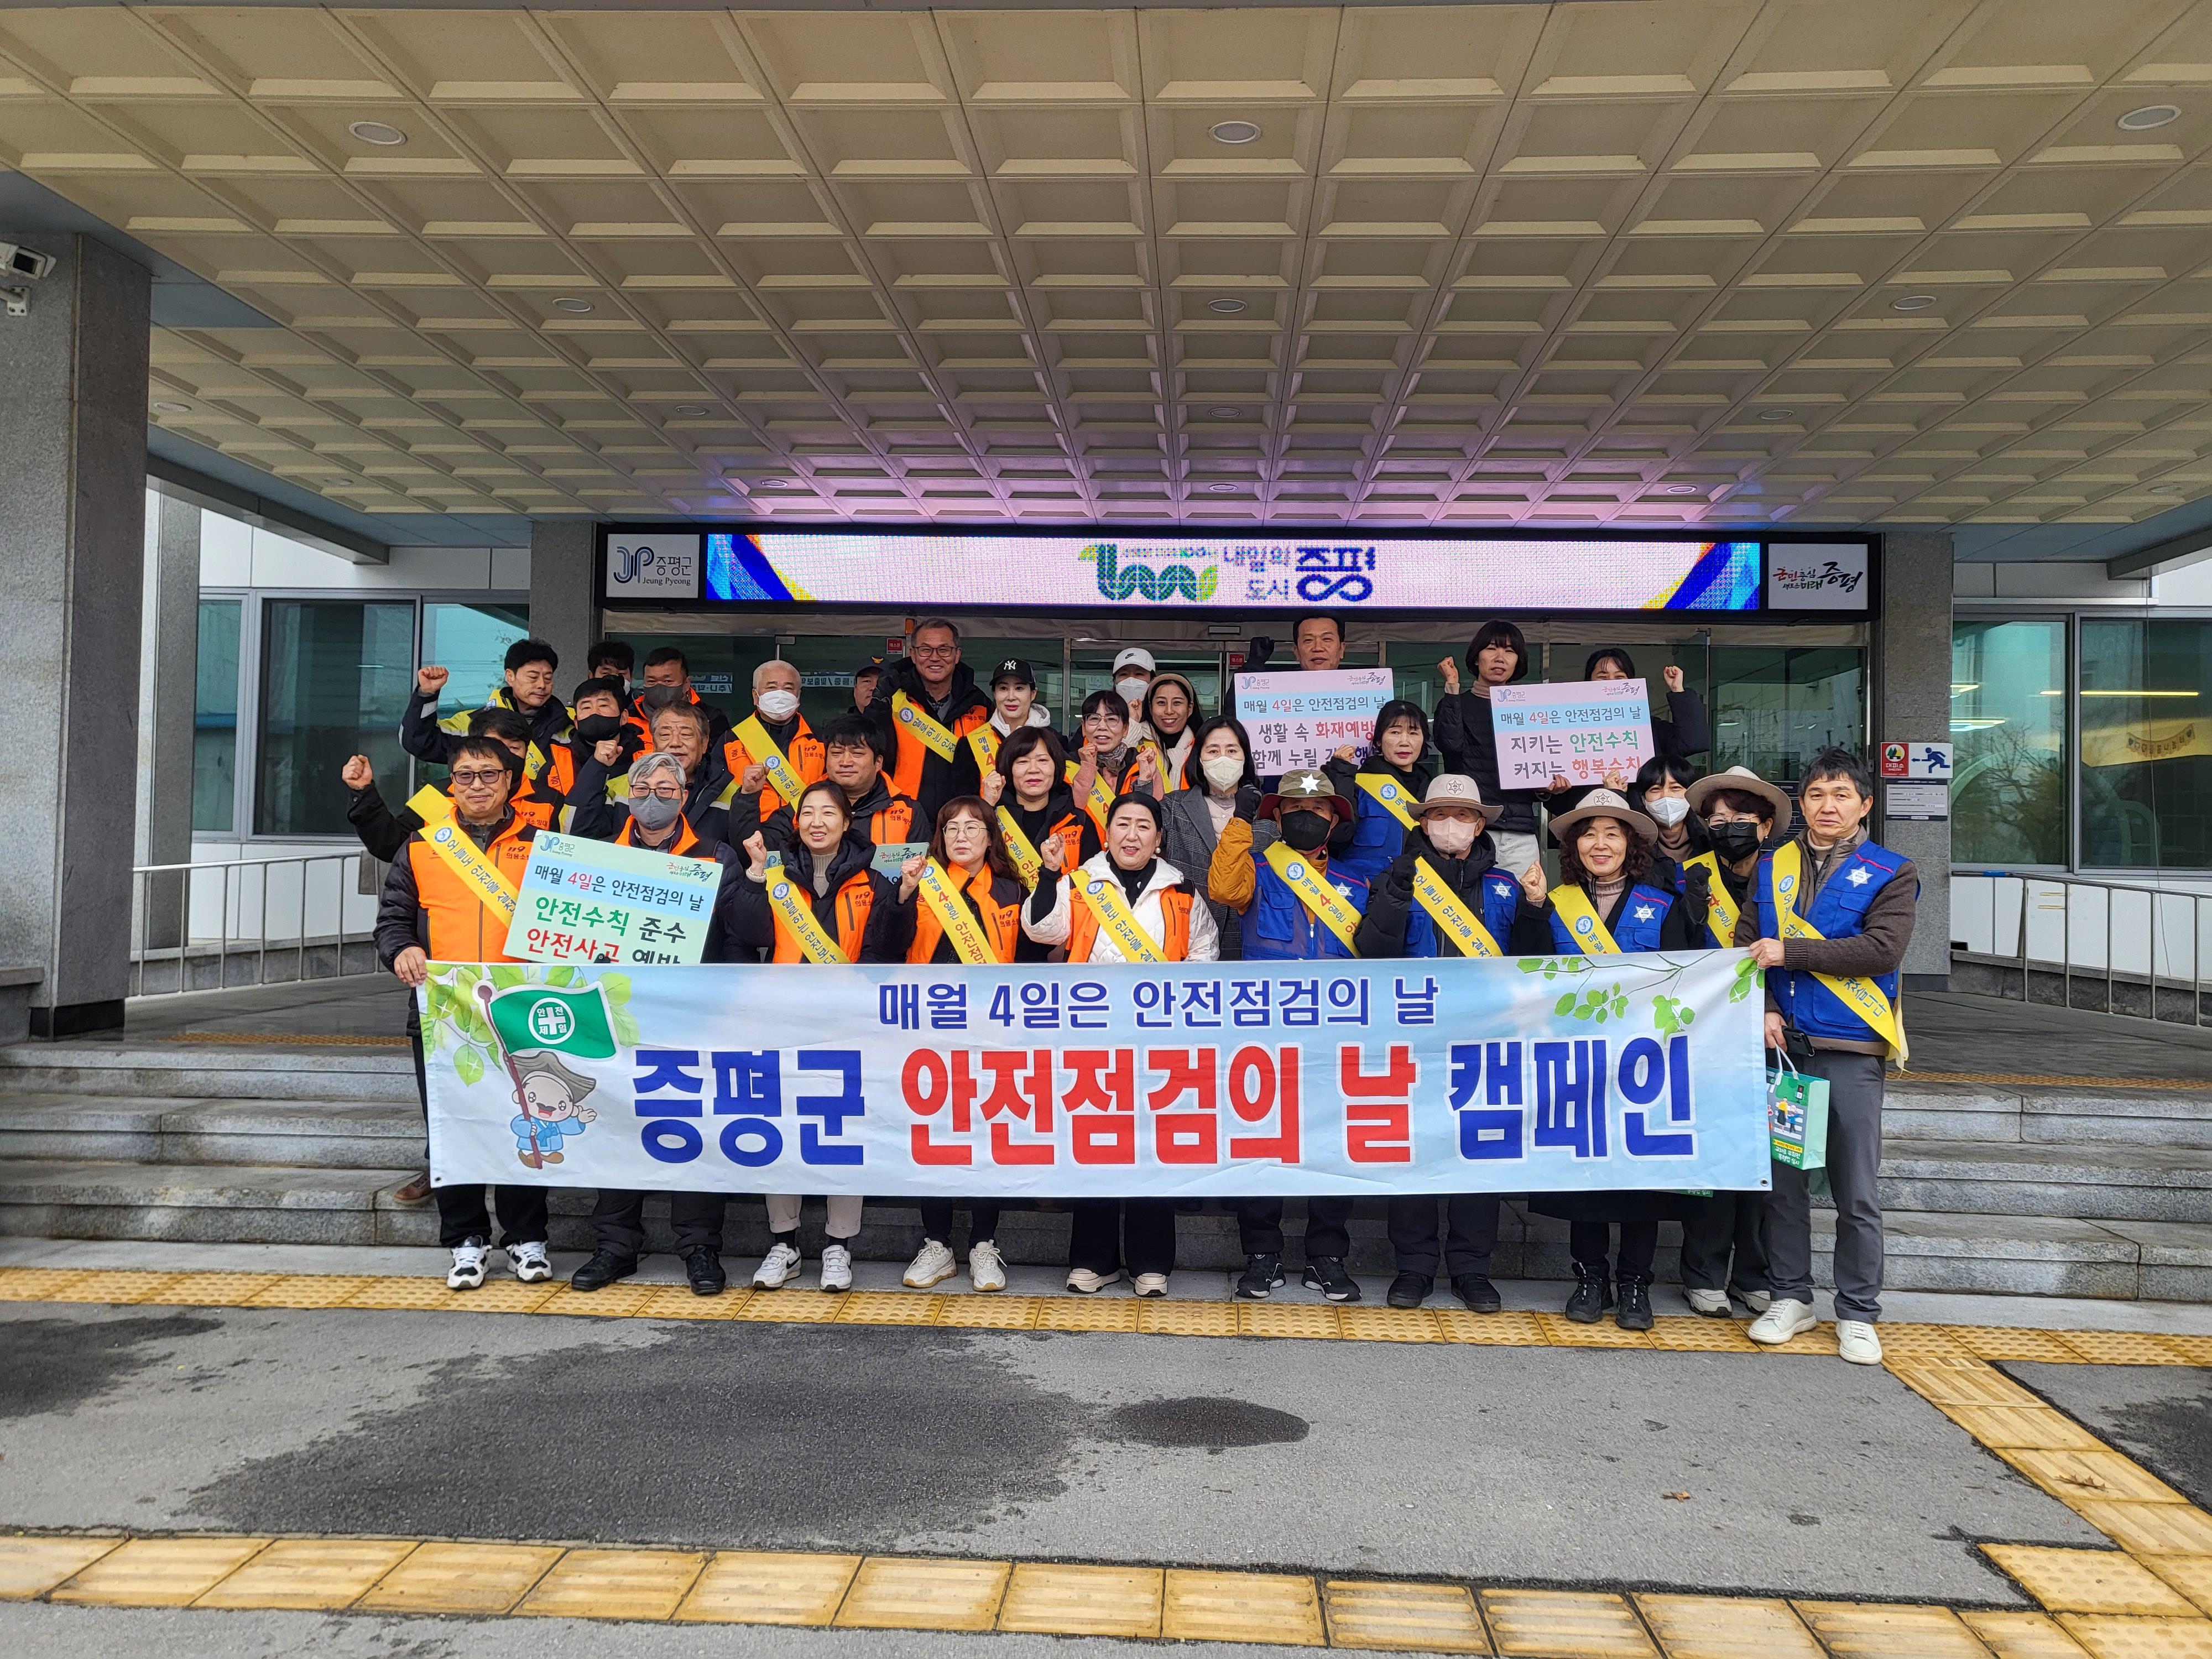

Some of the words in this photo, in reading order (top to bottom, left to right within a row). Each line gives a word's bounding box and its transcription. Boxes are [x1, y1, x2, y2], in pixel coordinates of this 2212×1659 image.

[656, 556, 692, 576] 증평군
[1223, 546, 1290, 572] 내일의
[642, 577, 663, 586] Jeung
[665, 577, 691, 586] Pyeong
[1817, 561, 1864, 593] 증평
[1245, 578, 1290, 601] 도시
[1004, 660, 1016, 670] NY
[1621, 682, 1641, 696] 증평
[1244, 699, 1267, 713] 매월
[1272, 698, 1305, 713] 4일은
[1308, 696, 1369, 712] 안전점검의
[1374, 696, 1386, 709] 날
[1500, 712, 1525, 726] 매월
[1529, 710, 1562, 724] 4일은
[1565, 707, 1625, 723] 안전점검의
[1629, 706, 1641, 719] 날
[1259, 722, 1288, 744] 생활
[1294, 722, 1310, 742] 속
[1315, 721, 1375, 741] 화재예방
[1511, 735, 1563, 754] 지키는
[1569, 731, 1639, 753] 안전수칙
[978, 736, 990, 753] 매월
[1251, 749, 1282, 770] 함께
[1288, 748, 1317, 768] 누릴
[1514, 761, 1566, 780] 커지는
[447, 839, 474, 867] 오늘도
[471, 864, 500, 894] 안전을
[691, 863, 713, 882] 증평
[535, 865, 564, 885] 매월
[567, 872, 606, 893] 4일은
[612, 880, 684, 906] 안전점검의
[689, 894, 705, 912] 날
[1301, 877, 1321, 895] 매월
[1416, 875, 1444, 905] 오늘도
[1442, 905, 1473, 938] 안전을
[536, 896, 630, 937] 안전수칙
[639, 916, 686, 943] 준수
[927, 876, 942, 893] 매월
[955, 921, 987, 964] 안전점
[1097, 893, 1119, 921] 오늘도
[1115, 920, 1143, 951] 안전을
[527, 928, 620, 963] 안전사고
[1587, 932, 1605, 952] 매월
[879, 983, 968, 1030] 매월
[989, 982, 1110, 1029] 4일은
[1133, 978, 1369, 1027] 안전점검의
[1395, 977, 1439, 1025] 날
[632, 1049, 866, 1167] 증평군
[901, 1047, 1300, 1166] 안전점검의
[1340, 1046, 1417, 1163] 날
[1448, 1035, 1694, 1159] 캠페인
